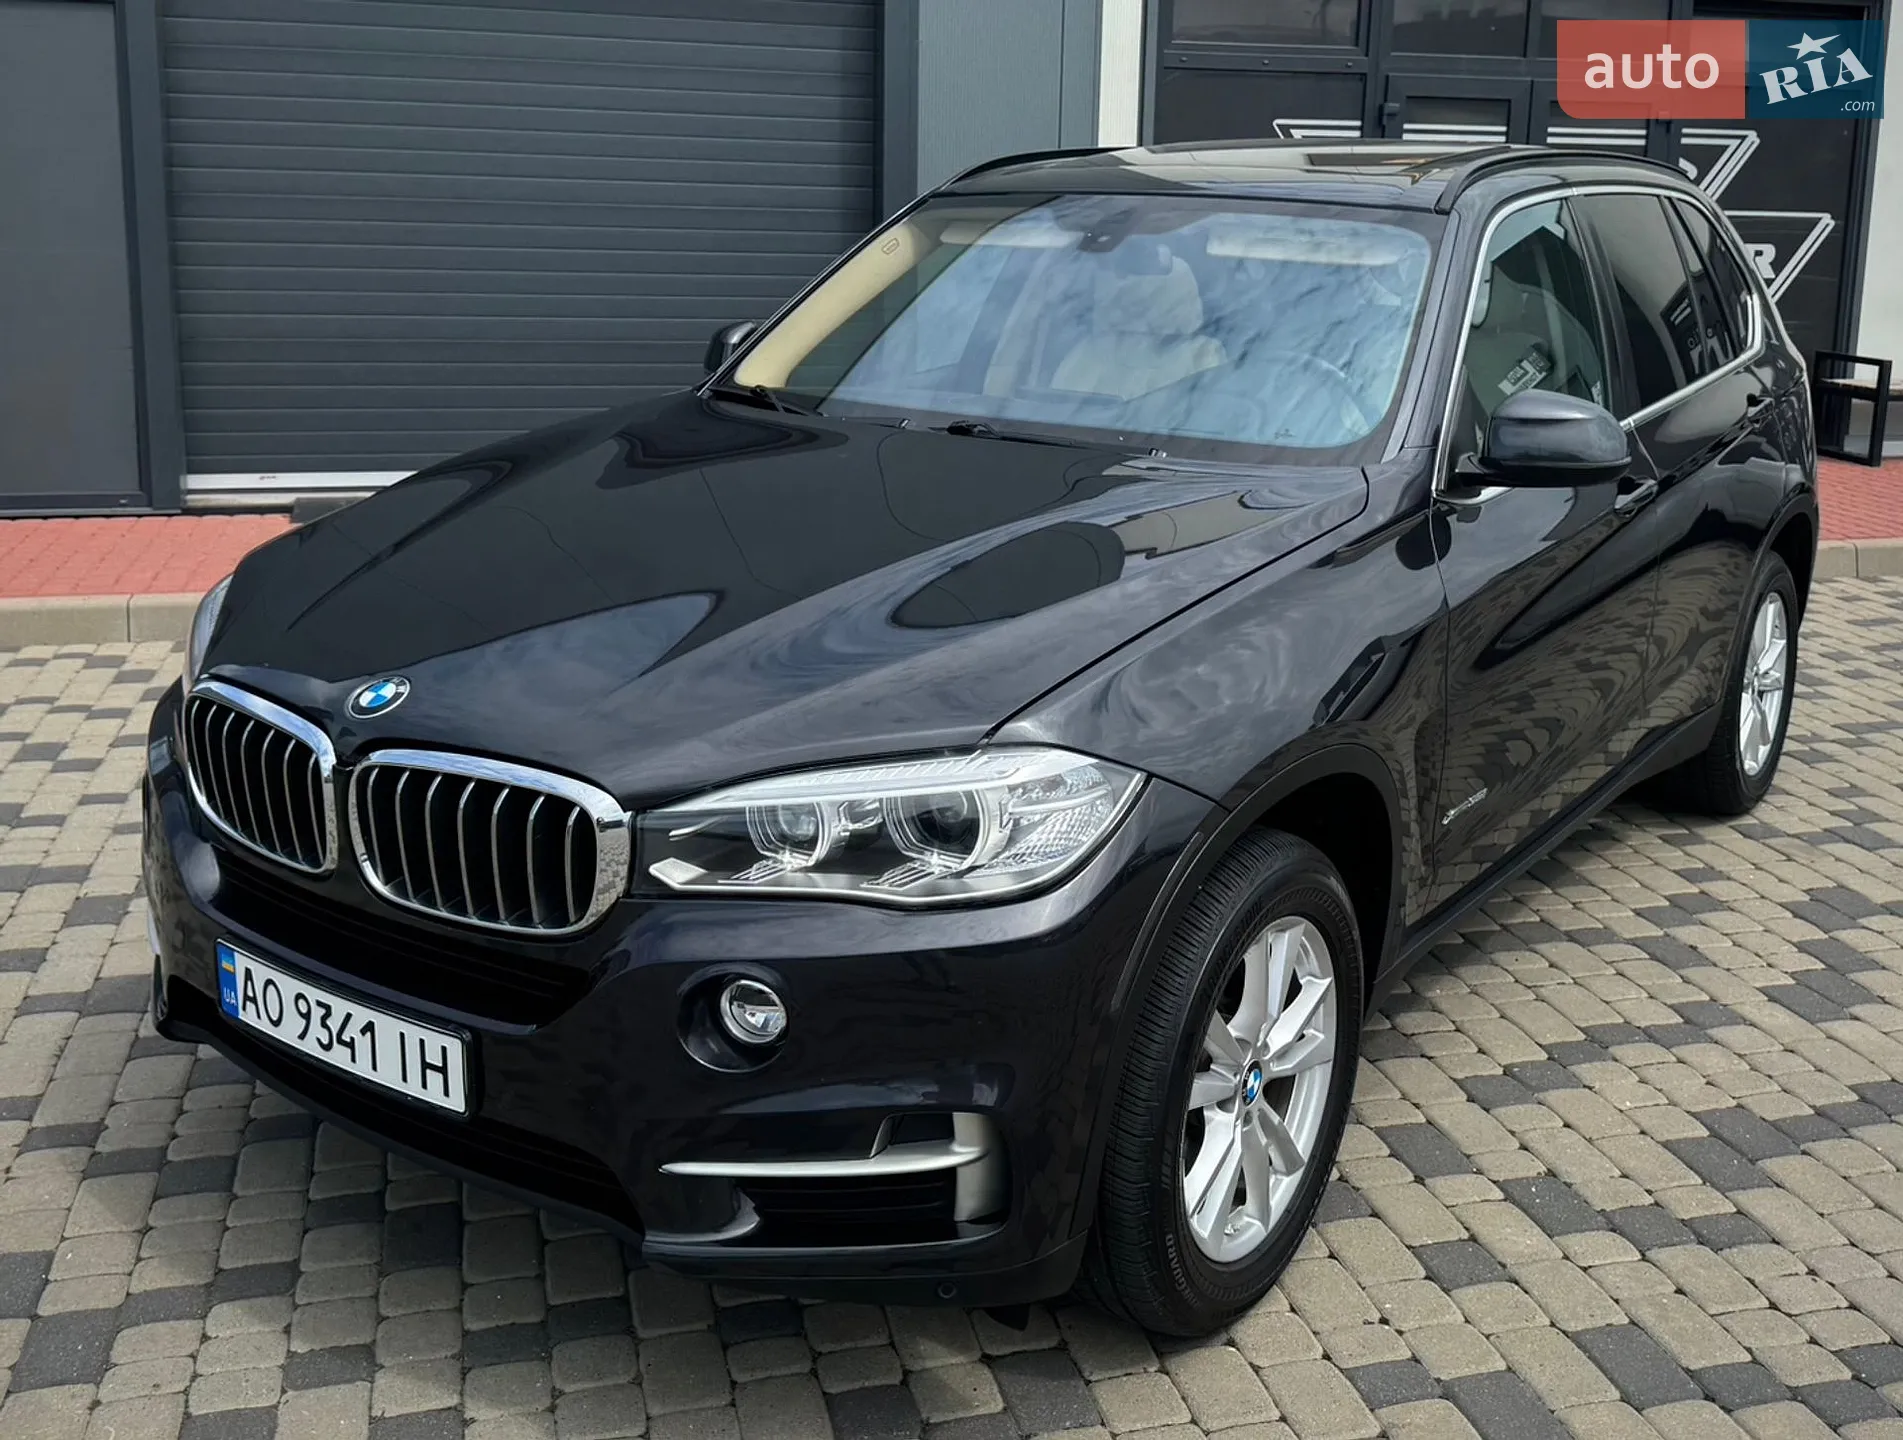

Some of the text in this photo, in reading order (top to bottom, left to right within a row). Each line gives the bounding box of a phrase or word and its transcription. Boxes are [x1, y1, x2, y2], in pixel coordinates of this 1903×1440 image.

[223, 987, 238, 1006] UA
[242, 966, 450, 1099] AO 9341 IH
